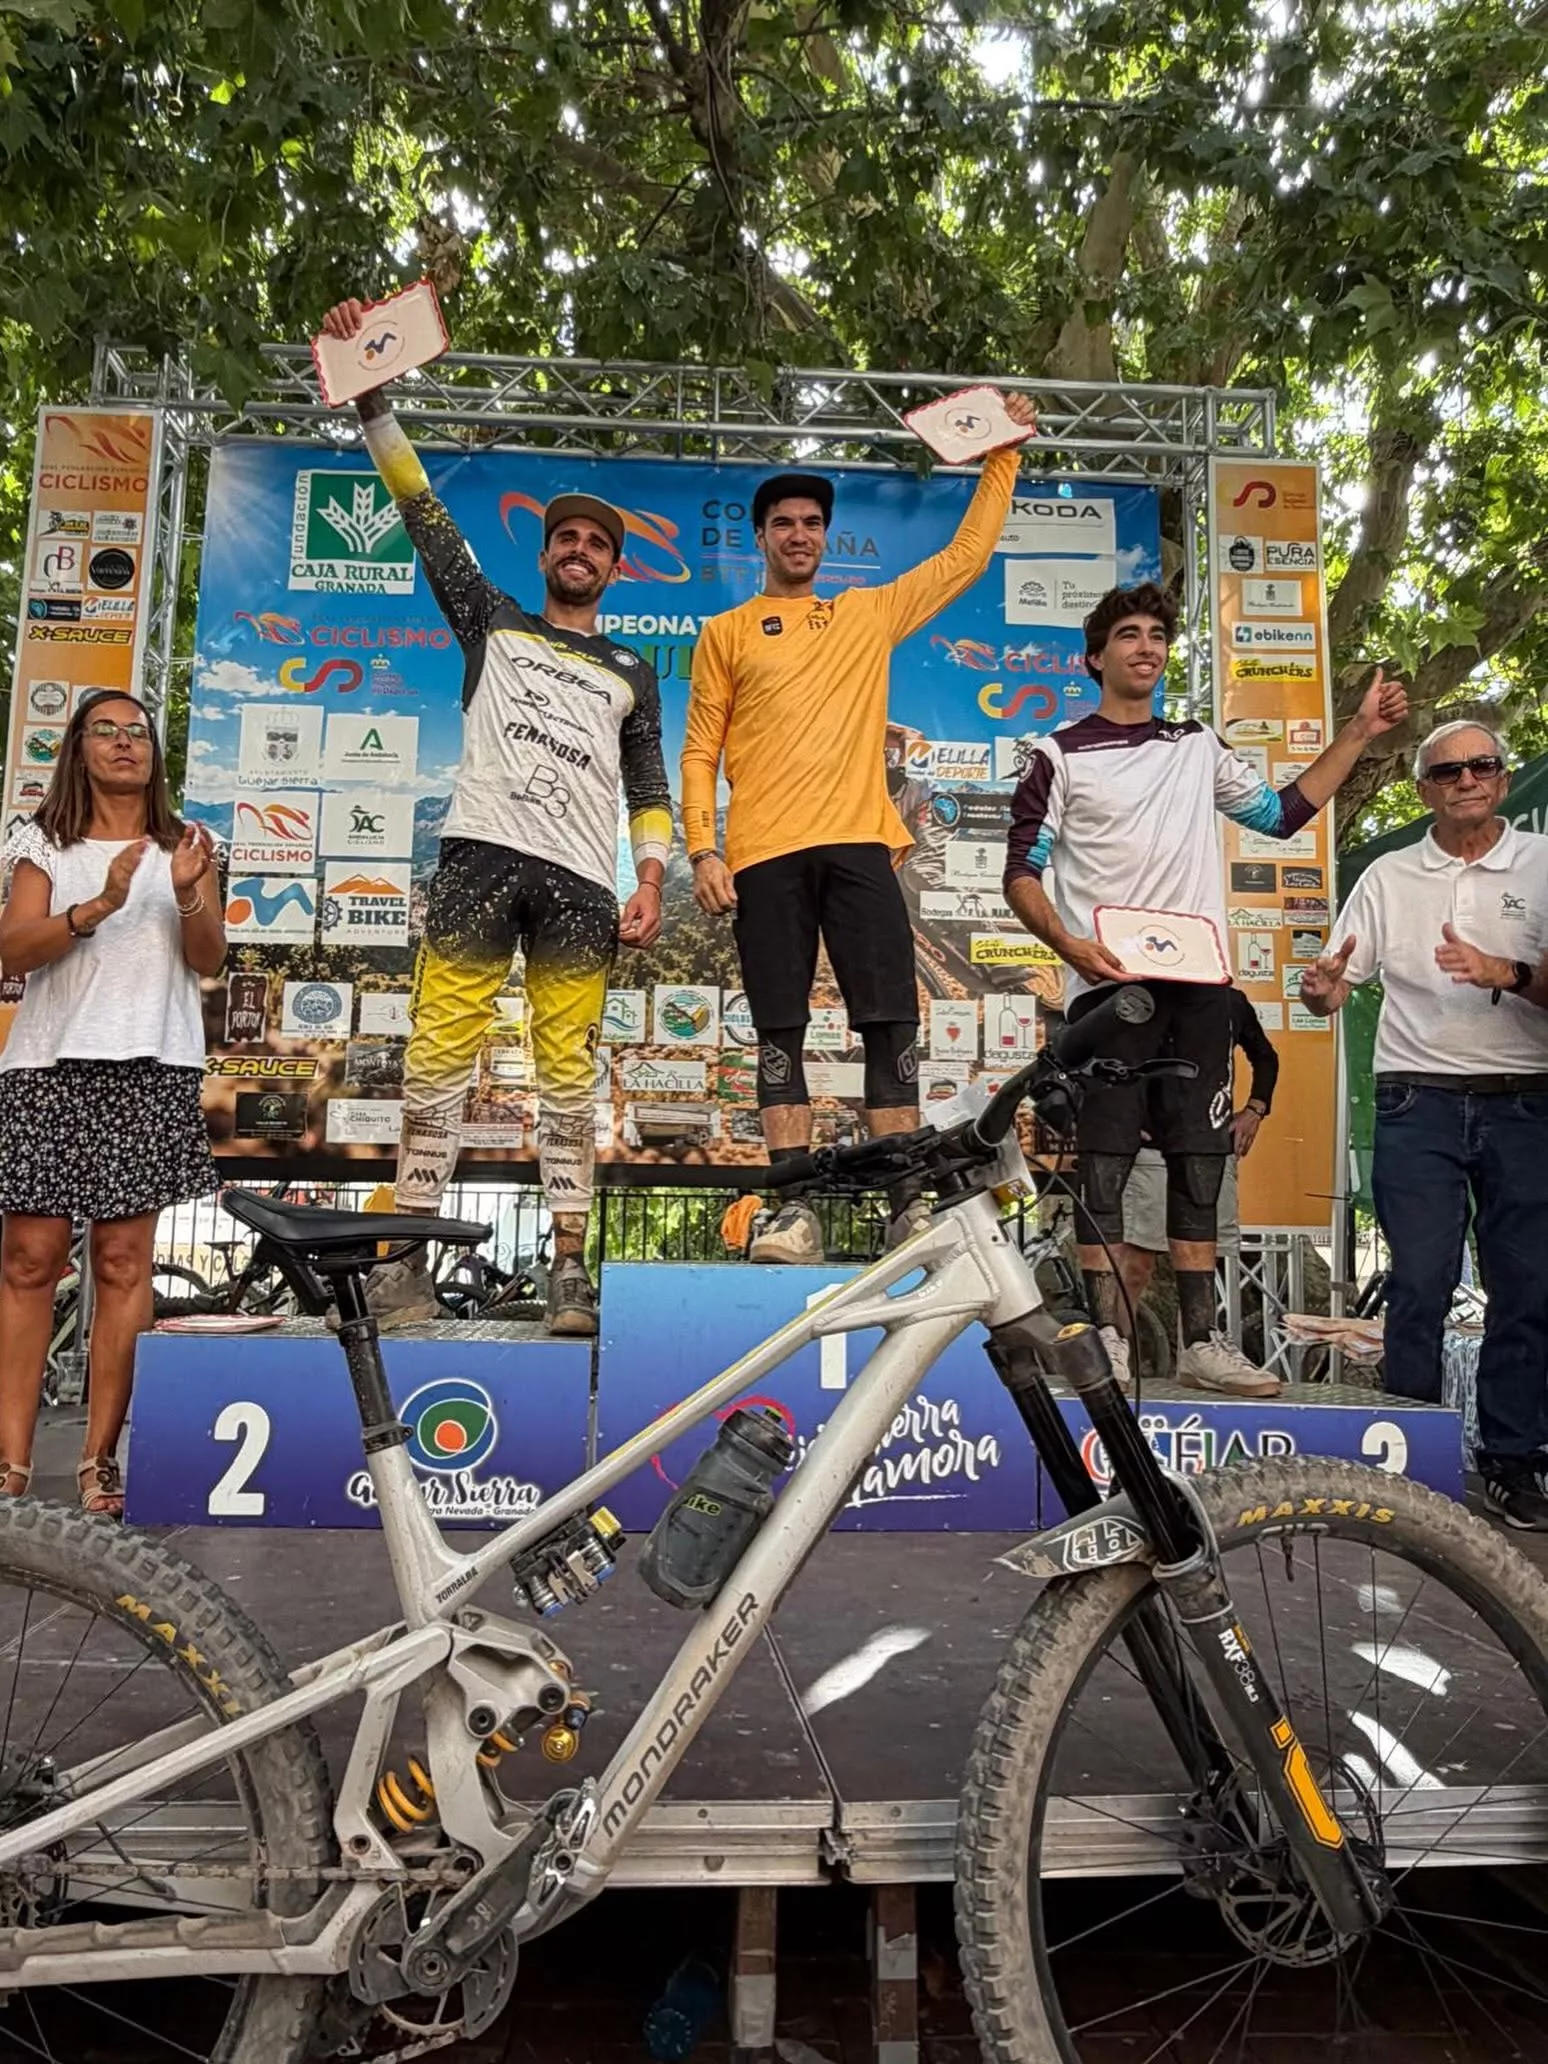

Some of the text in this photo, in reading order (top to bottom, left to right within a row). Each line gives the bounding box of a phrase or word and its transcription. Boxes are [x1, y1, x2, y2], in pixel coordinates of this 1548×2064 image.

[39, 473, 148, 492] CICLISMO
[292, 472, 309, 561] fundación
[1010, 499, 1103, 519] KODA
[702, 527, 742, 548] DE
[1266, 543, 1315, 557] PURA
[292, 563, 413, 582] CAJA RURAL
[315, 580, 386, 594] GRANADA
[28, 624, 133, 644] X-SAUCE
[311, 625, 451, 649] CICLISMO
[1255, 628, 1313, 642] ebikenn
[511, 656, 613, 705] ORBEA
[232, 848, 313, 863] CICLISMO
[349, 895, 408, 908] TRAVEL
[347, 909, 407, 926] BIKE
[624, 1079, 642, 1089] LA
[208, 1401, 270, 1516] 2
[453, 1470, 538, 1506] Sierra
[444, 1506, 484, 1516] Nevada
[1236, 1497, 1397, 1527] MAXXIS
[115, 1594, 241, 1715] MAXXI
[602, 1591, 760, 1839] MONDRAKER
